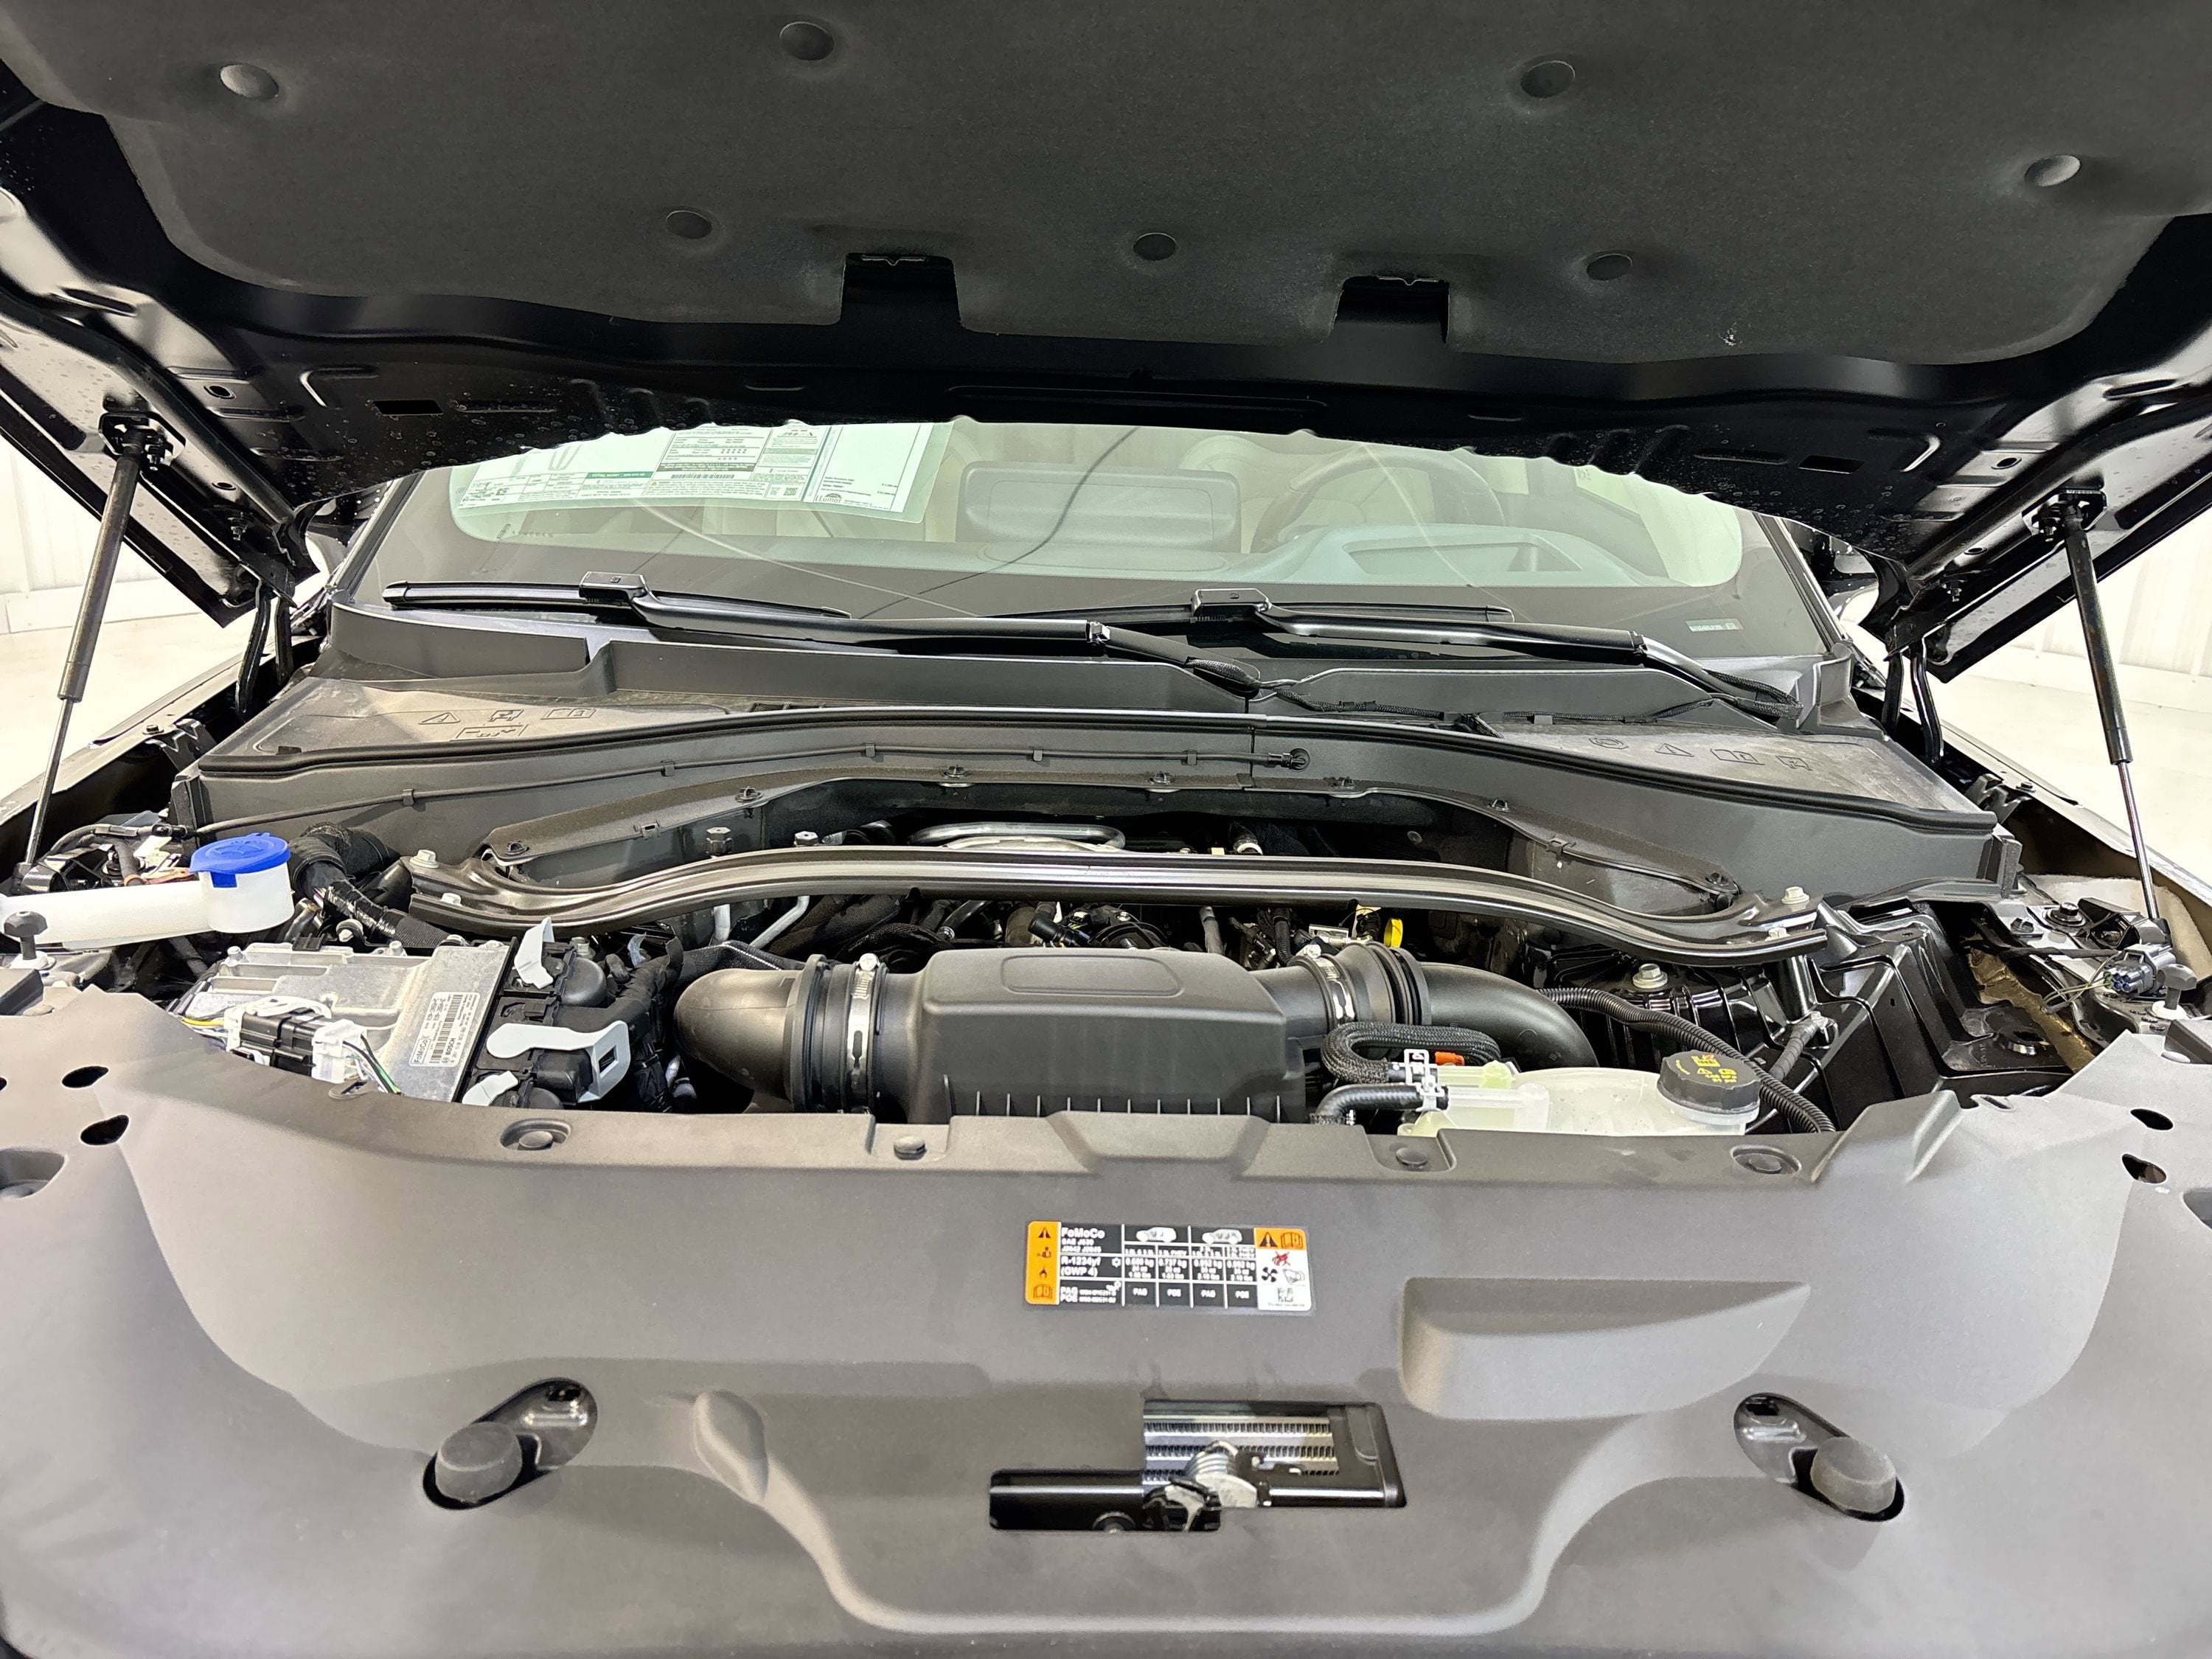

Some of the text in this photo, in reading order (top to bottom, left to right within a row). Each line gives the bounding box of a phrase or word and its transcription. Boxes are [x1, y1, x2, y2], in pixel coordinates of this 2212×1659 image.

[445, 1037, 456, 1055] BOSCH
[1061, 1227, 1105, 1239] FoMoCo
[1061, 1256, 1101, 1267] R-1234yf
[1132, 1287, 1148, 1297] PAG
[1200, 1289, 1216, 1298] PAG
